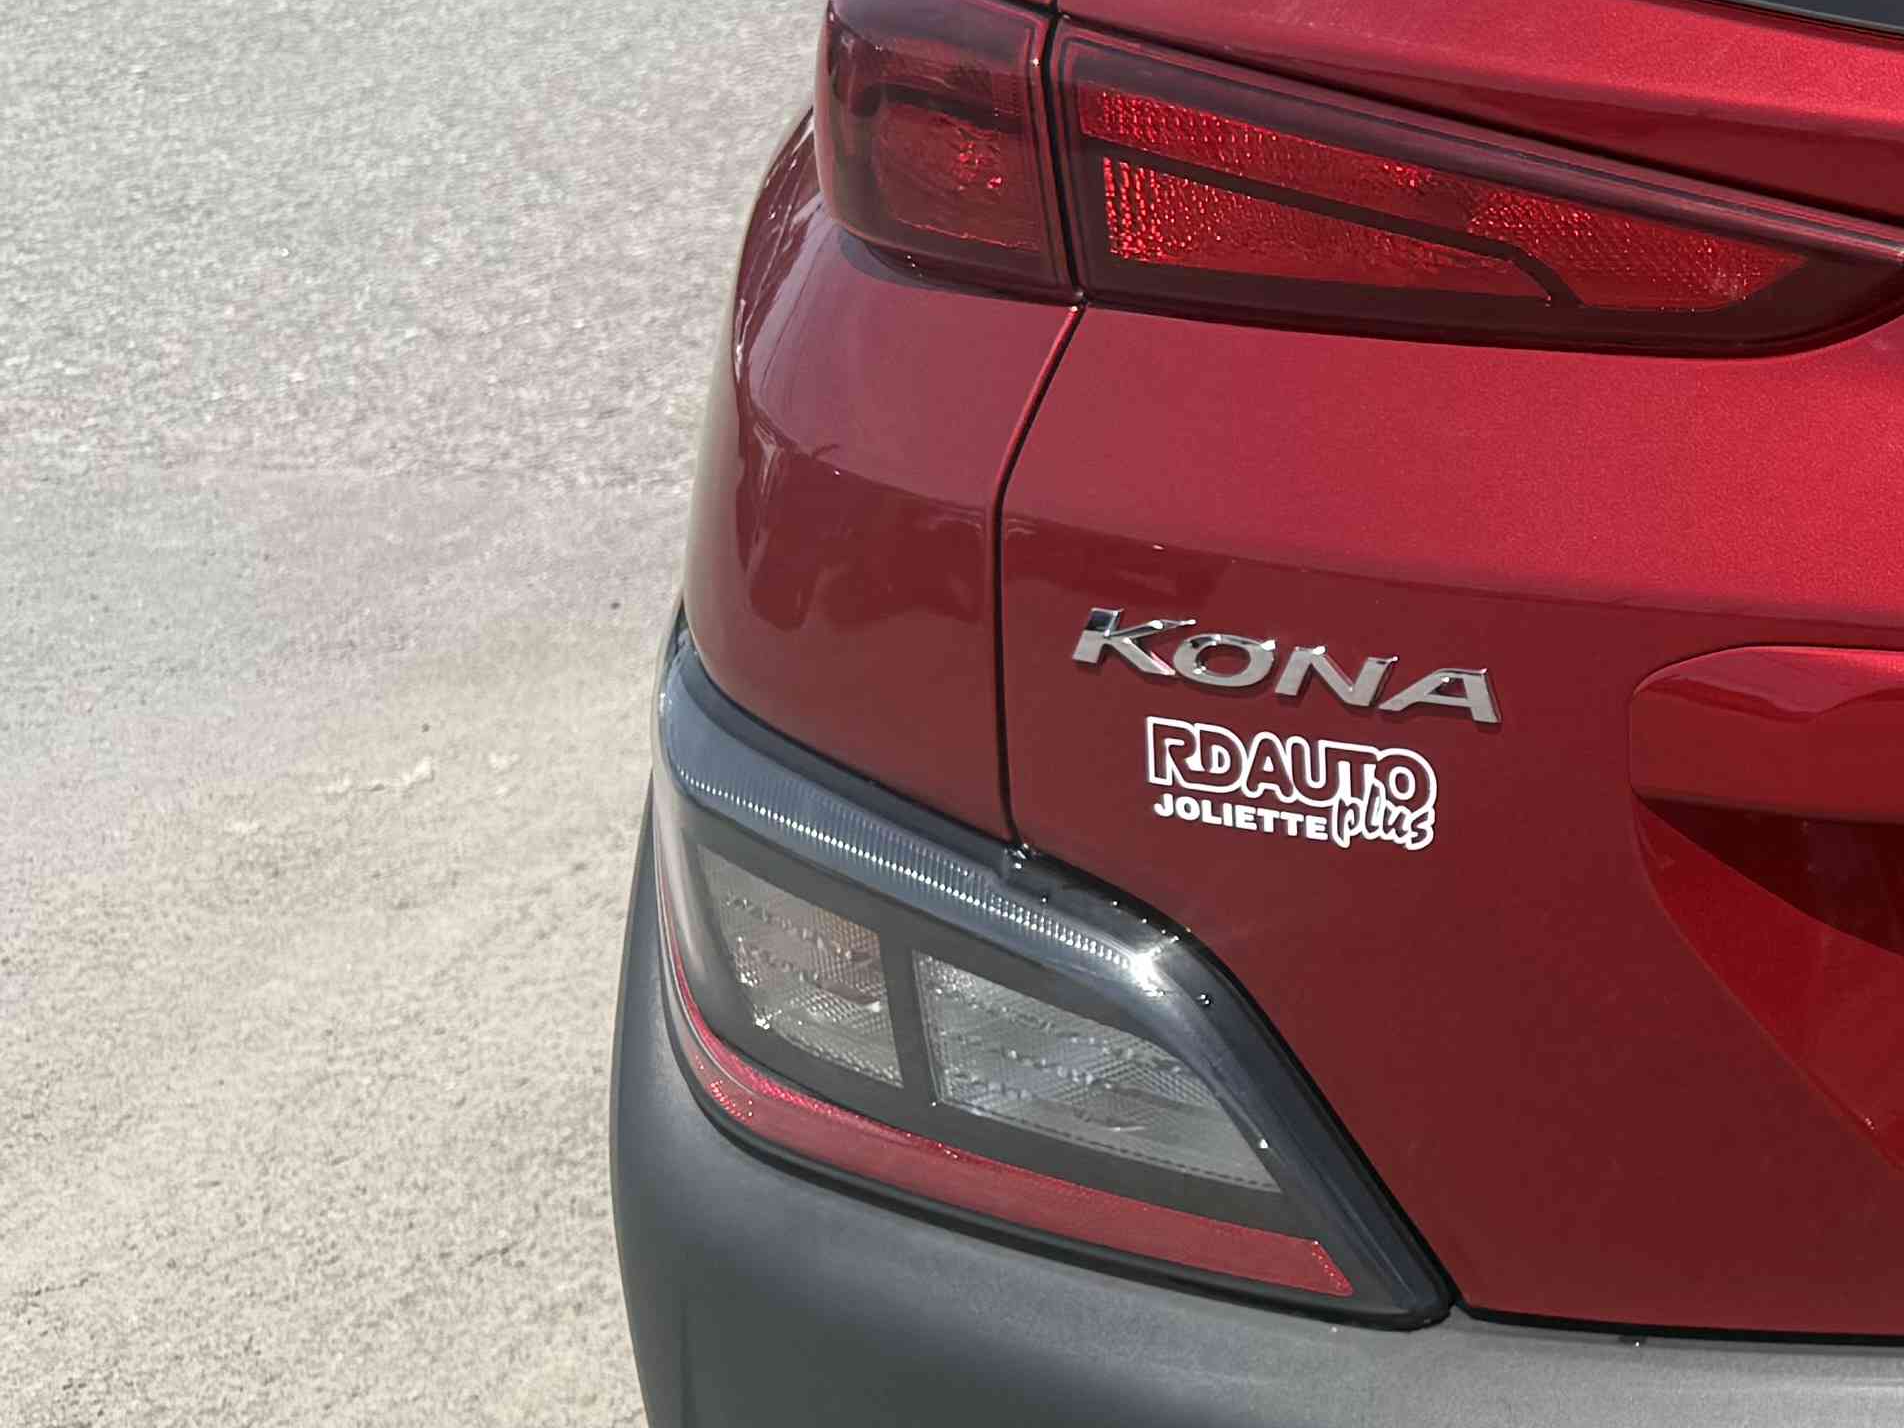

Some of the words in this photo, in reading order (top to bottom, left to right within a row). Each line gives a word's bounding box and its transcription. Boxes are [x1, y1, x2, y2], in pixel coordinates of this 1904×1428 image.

[1072, 607, 1501, 724] KONA
[1154, 792, 1329, 842] JOLIETTE
[1331, 778, 1437, 851] plus
